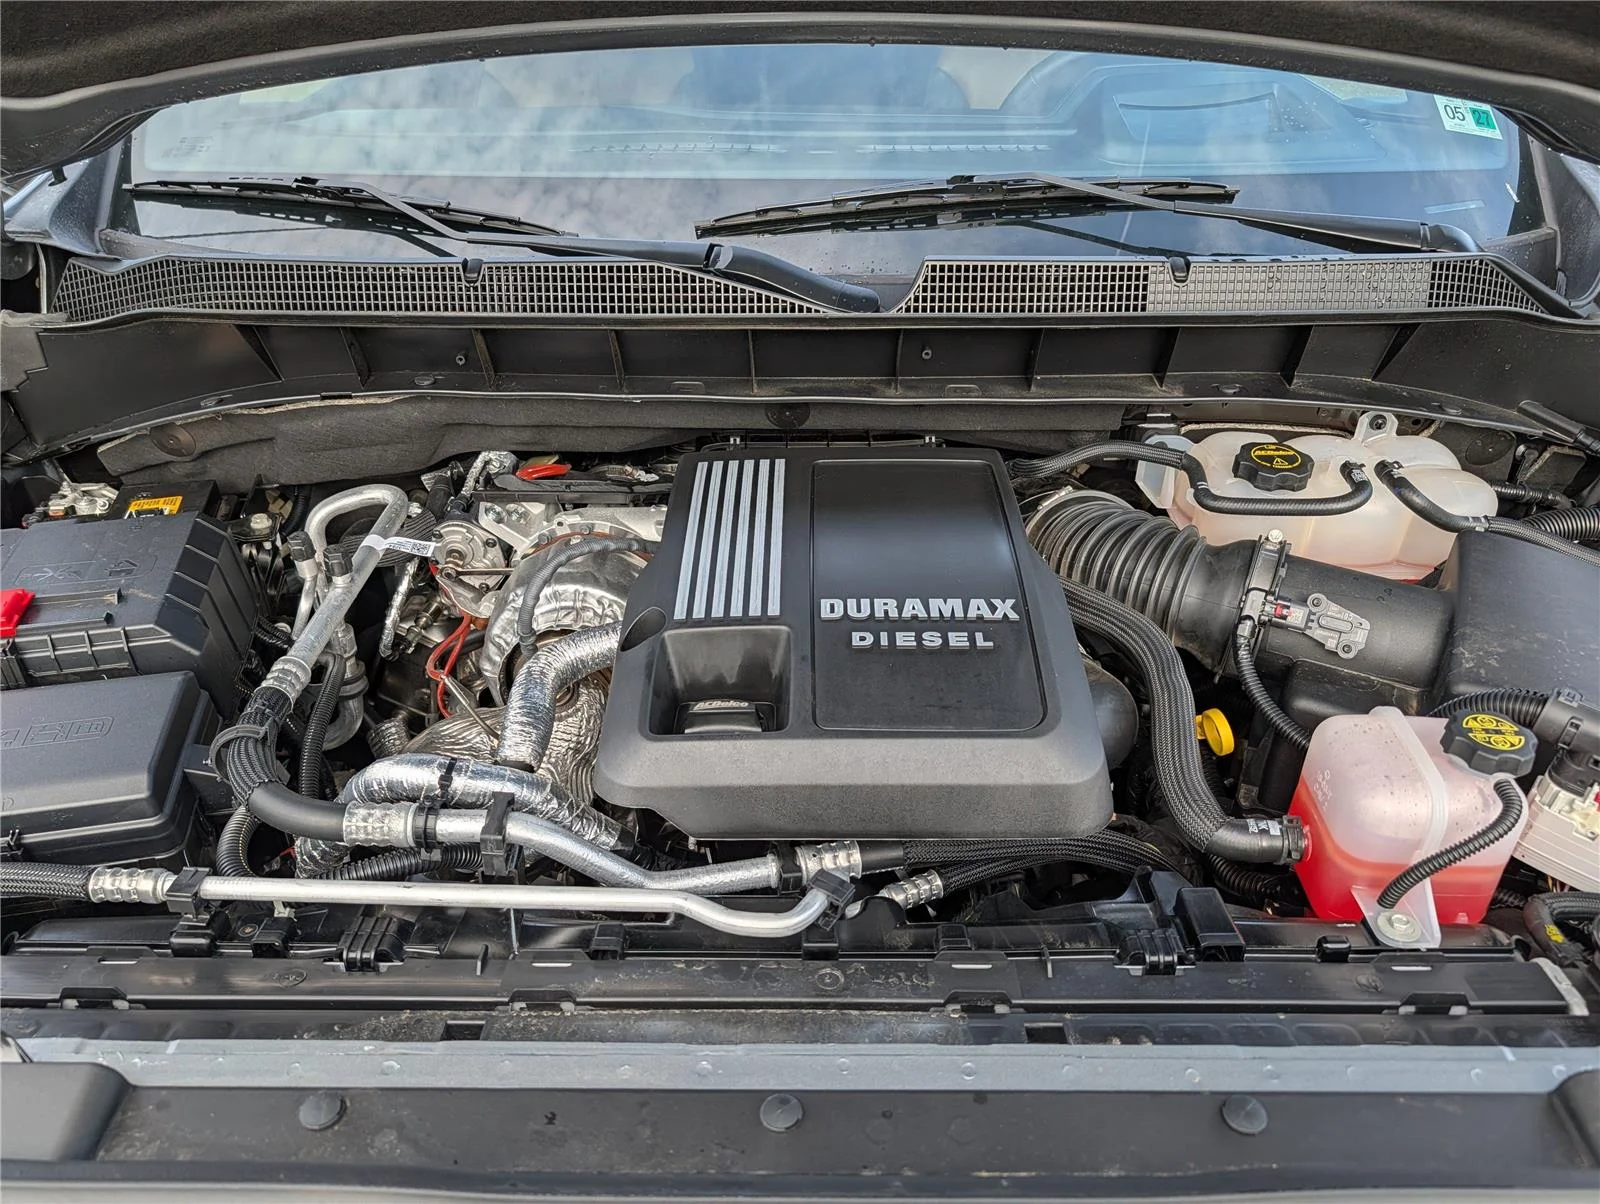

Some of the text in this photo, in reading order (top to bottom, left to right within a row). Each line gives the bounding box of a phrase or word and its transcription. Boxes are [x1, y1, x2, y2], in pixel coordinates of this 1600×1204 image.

[1444, 104, 1492, 127] 05 27
[820, 598, 1020, 621] DURAMAX
[851, 631, 994, 649] DIESEL
